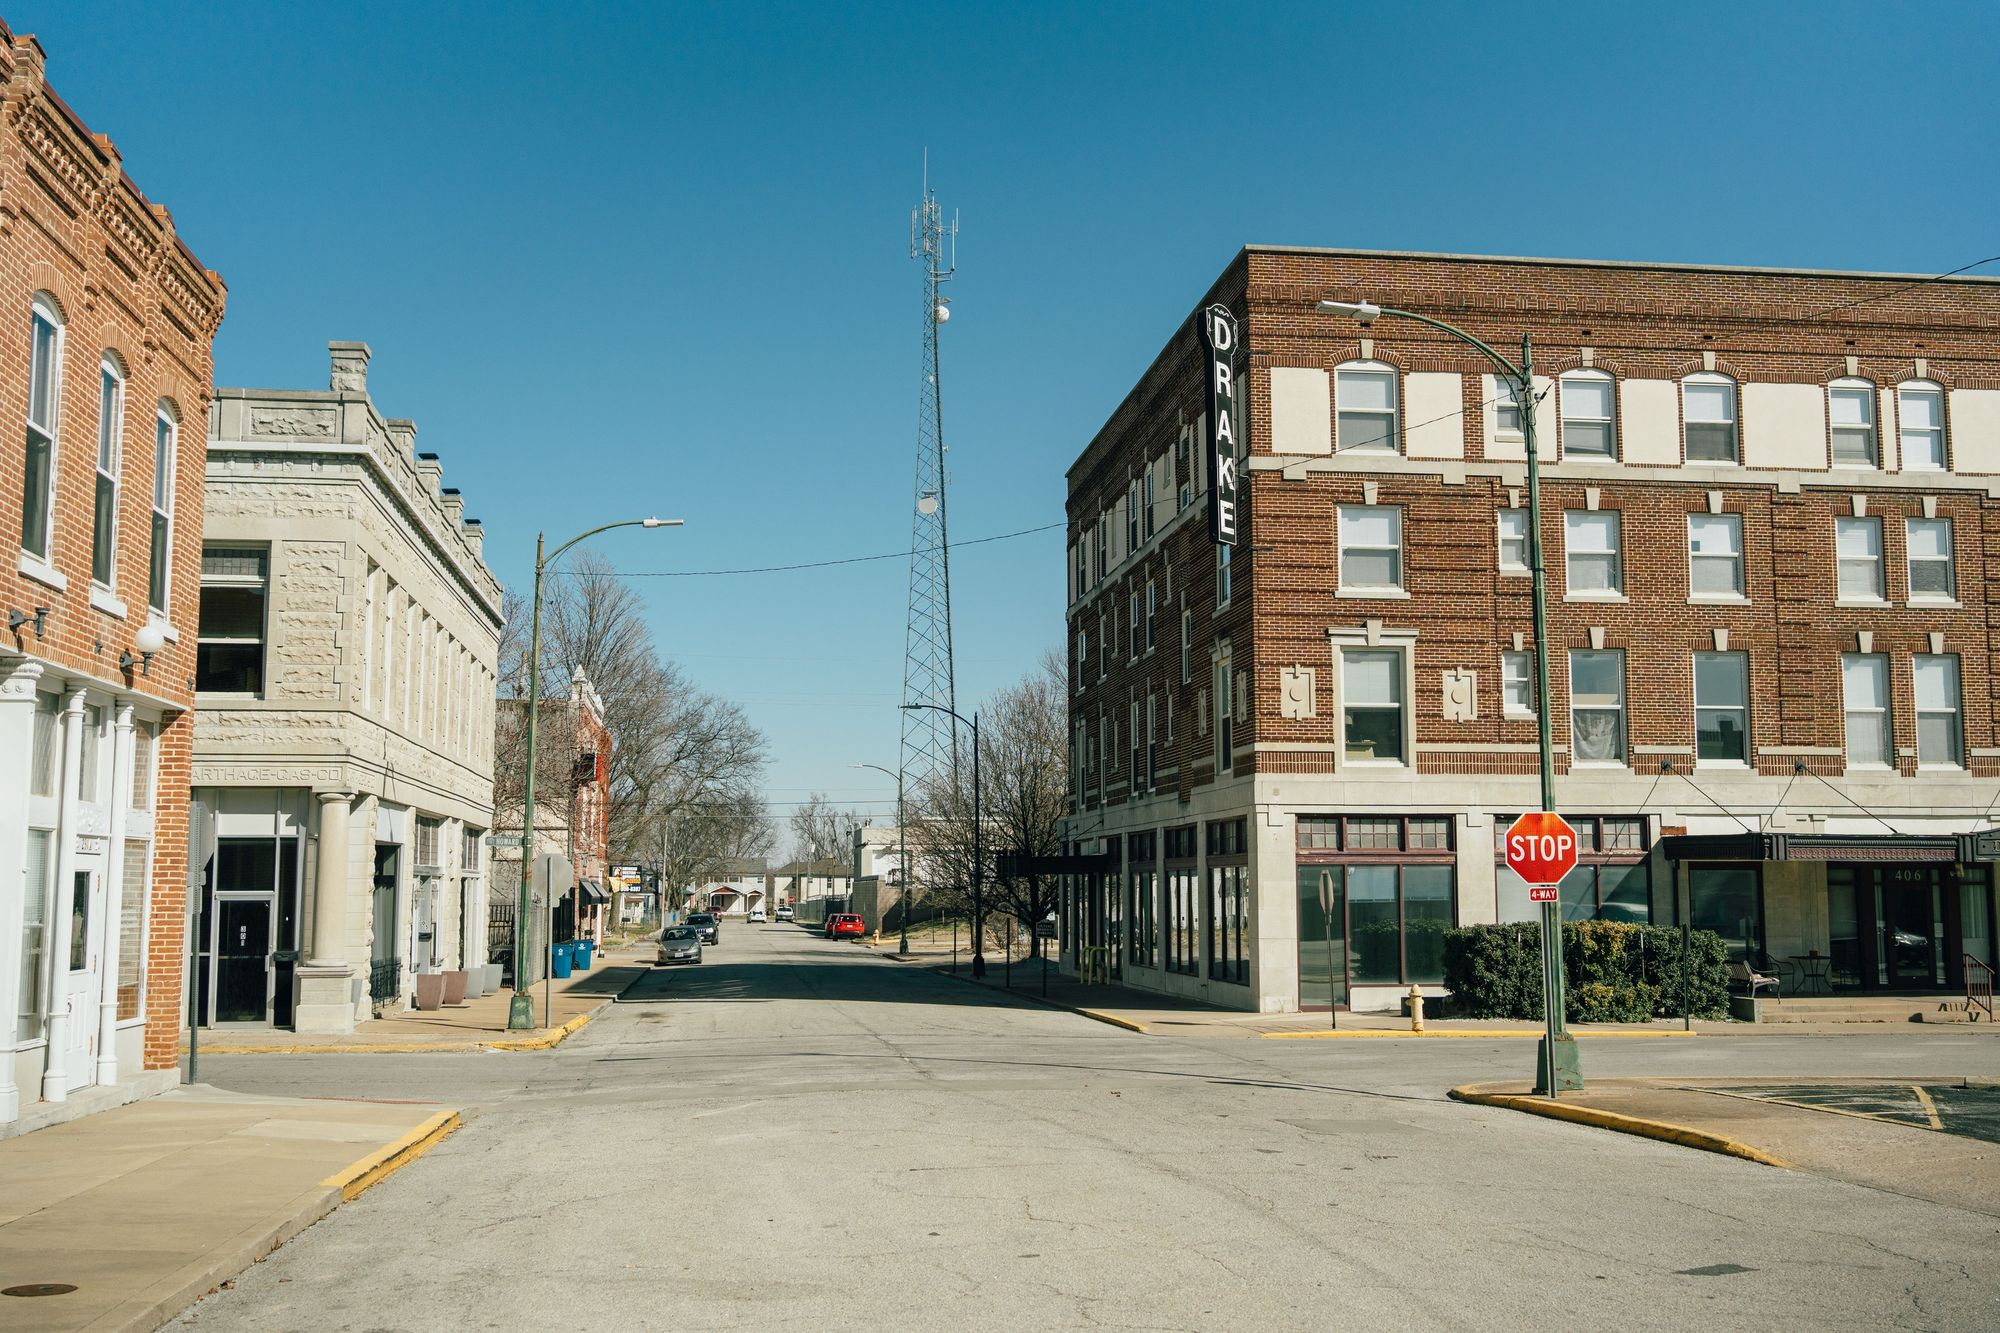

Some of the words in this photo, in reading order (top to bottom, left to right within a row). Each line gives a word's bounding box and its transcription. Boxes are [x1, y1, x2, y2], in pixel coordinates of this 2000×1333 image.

[1214, 315, 1236, 536] DRAKE
[1510, 835, 1572, 862] STOP
[1895, 870, 1921, 880] 406
[1531, 890, 1556, 899] 4-WAY
